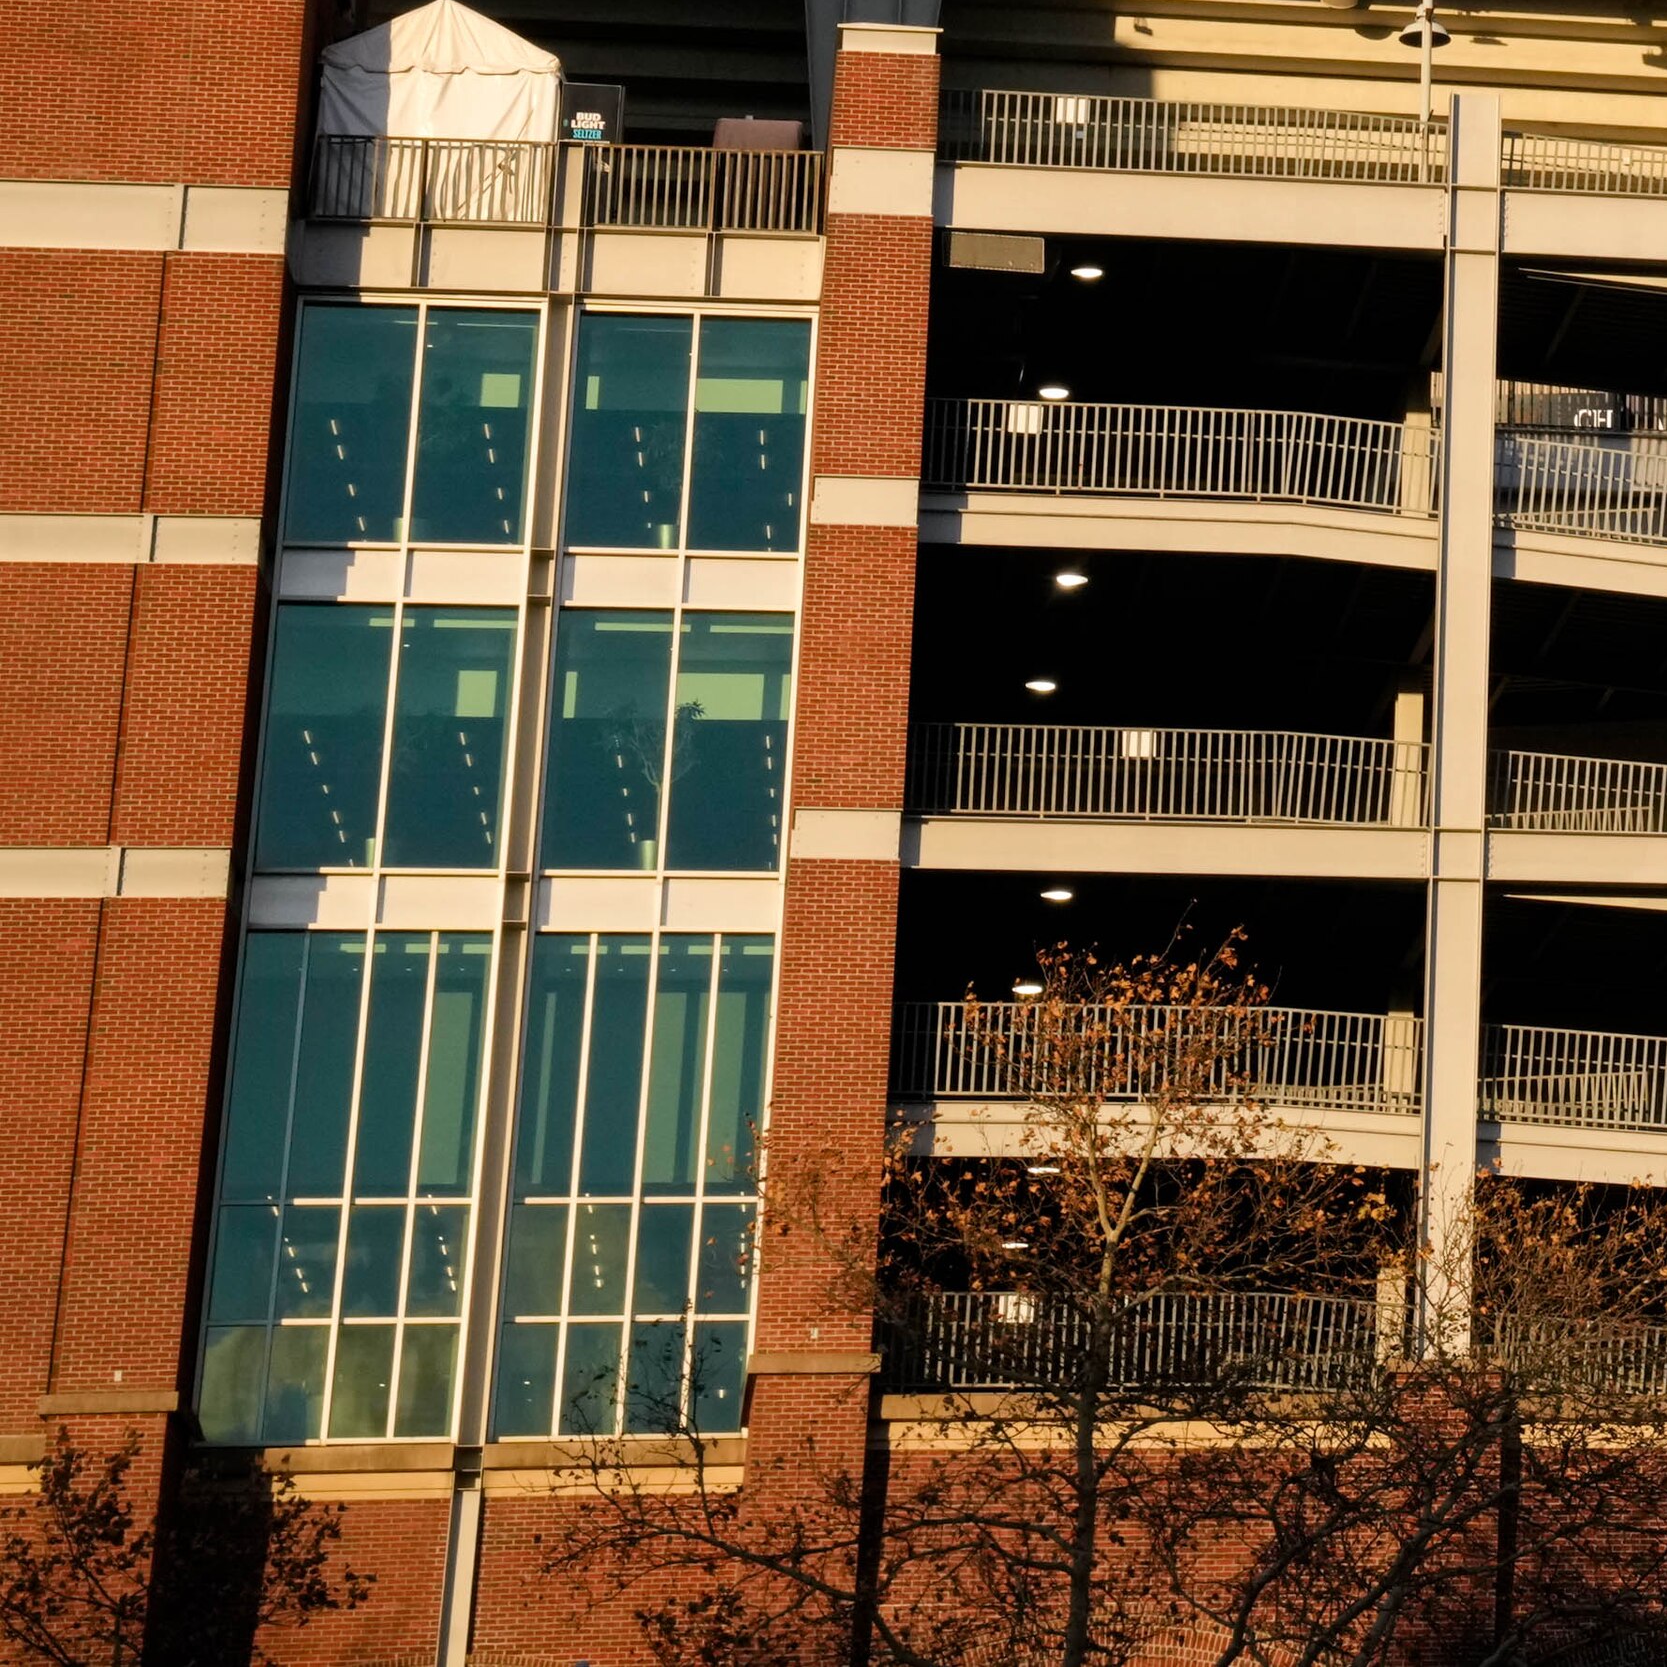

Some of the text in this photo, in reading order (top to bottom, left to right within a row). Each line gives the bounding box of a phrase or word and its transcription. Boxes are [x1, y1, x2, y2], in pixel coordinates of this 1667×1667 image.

[576, 112, 601, 121] BUD
[570, 119, 606, 129] LIGHT
[573, 129, 602, 140] SELTZER
